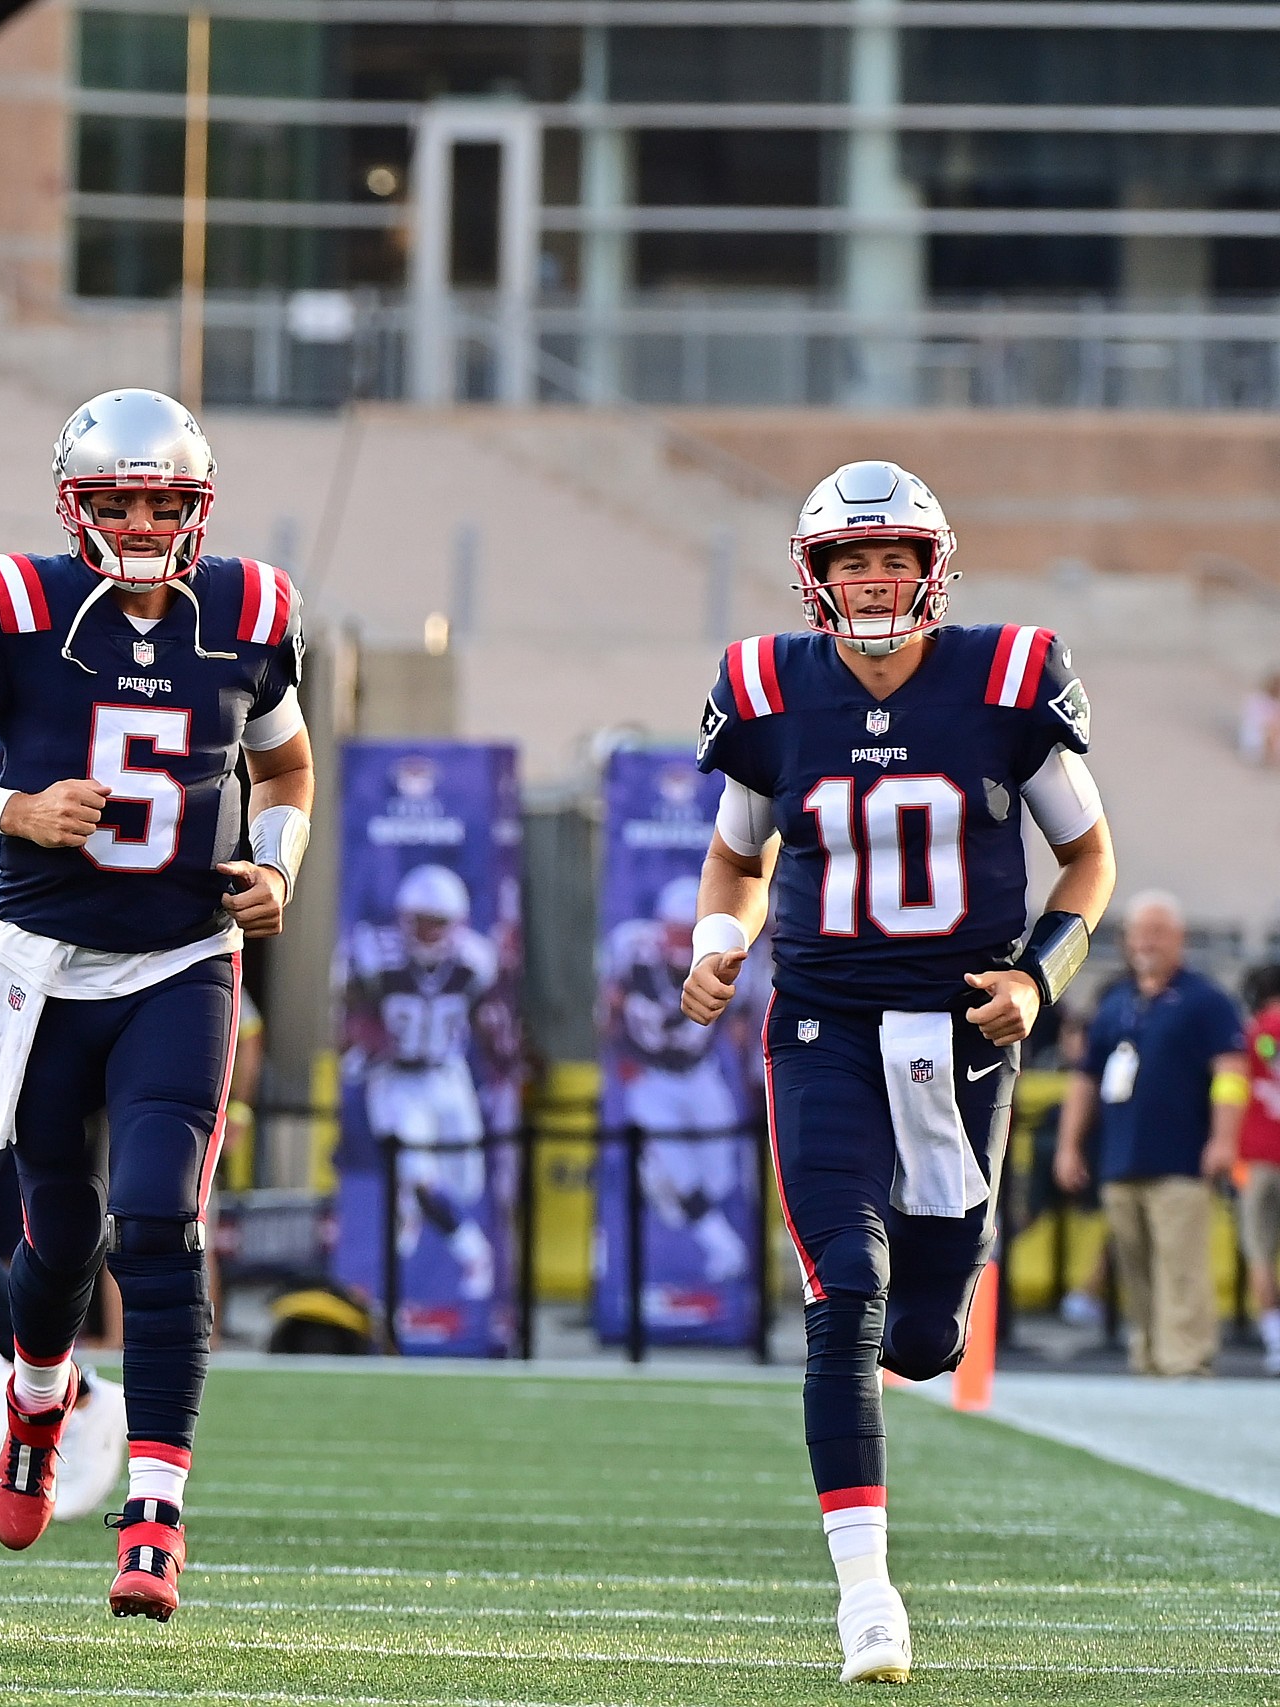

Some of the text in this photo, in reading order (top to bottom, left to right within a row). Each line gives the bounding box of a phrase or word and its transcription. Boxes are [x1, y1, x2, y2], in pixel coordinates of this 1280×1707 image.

[129, 461, 158, 469] PATRIOTS
[118, 676, 172, 693] PATRIOTS
[851, 747, 907, 763] PATRIOTS
[79, 701, 192, 874] 5
[802, 772, 969, 938] 10
[911, 1069, 932, 1082] NFL
